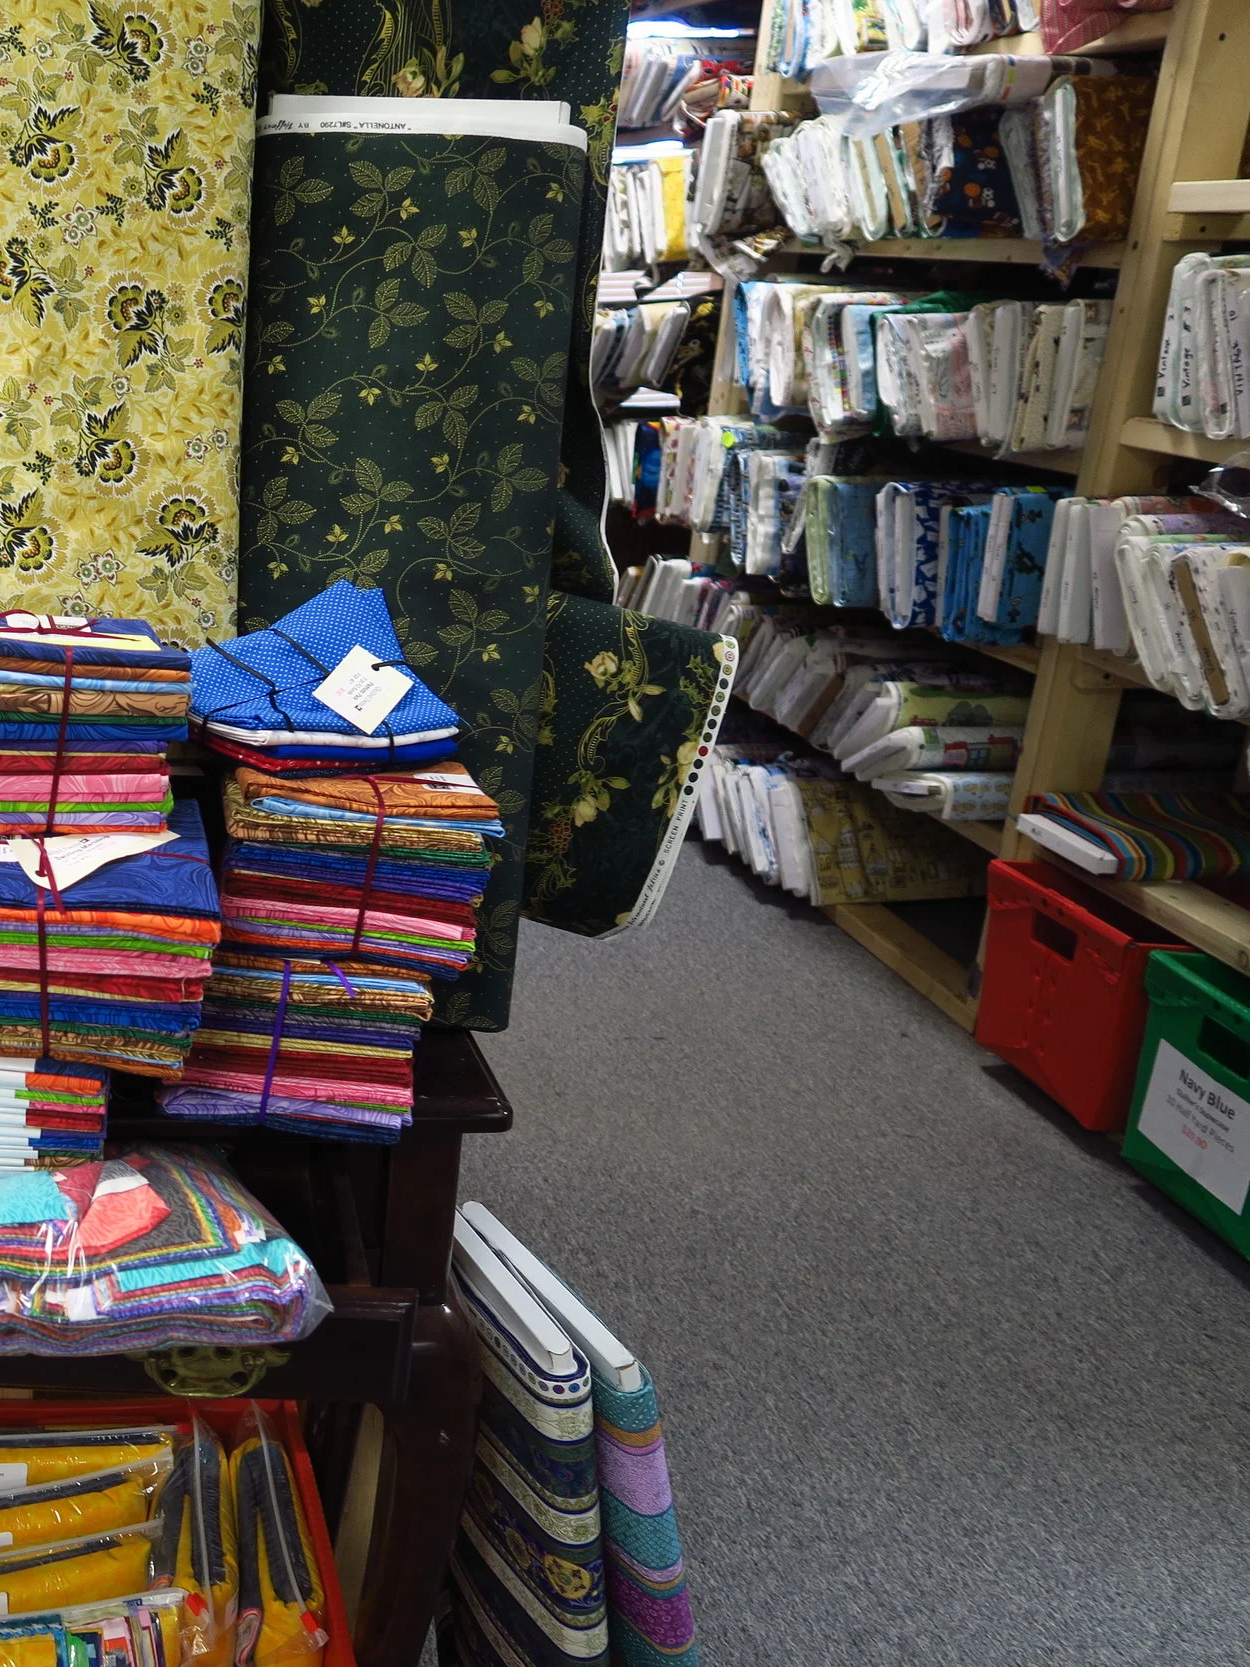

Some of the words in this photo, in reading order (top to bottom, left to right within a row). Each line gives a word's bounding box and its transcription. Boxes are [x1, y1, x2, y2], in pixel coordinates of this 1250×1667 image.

[354, 122, 411, 131] "ANTONELLA"
[664, 826, 679, 854] SCREEN
[676, 800, 688, 822] PRINT
[1179, 1069, 1208, 1103] Navy
[1207, 1092, 1235, 1120] Blue
